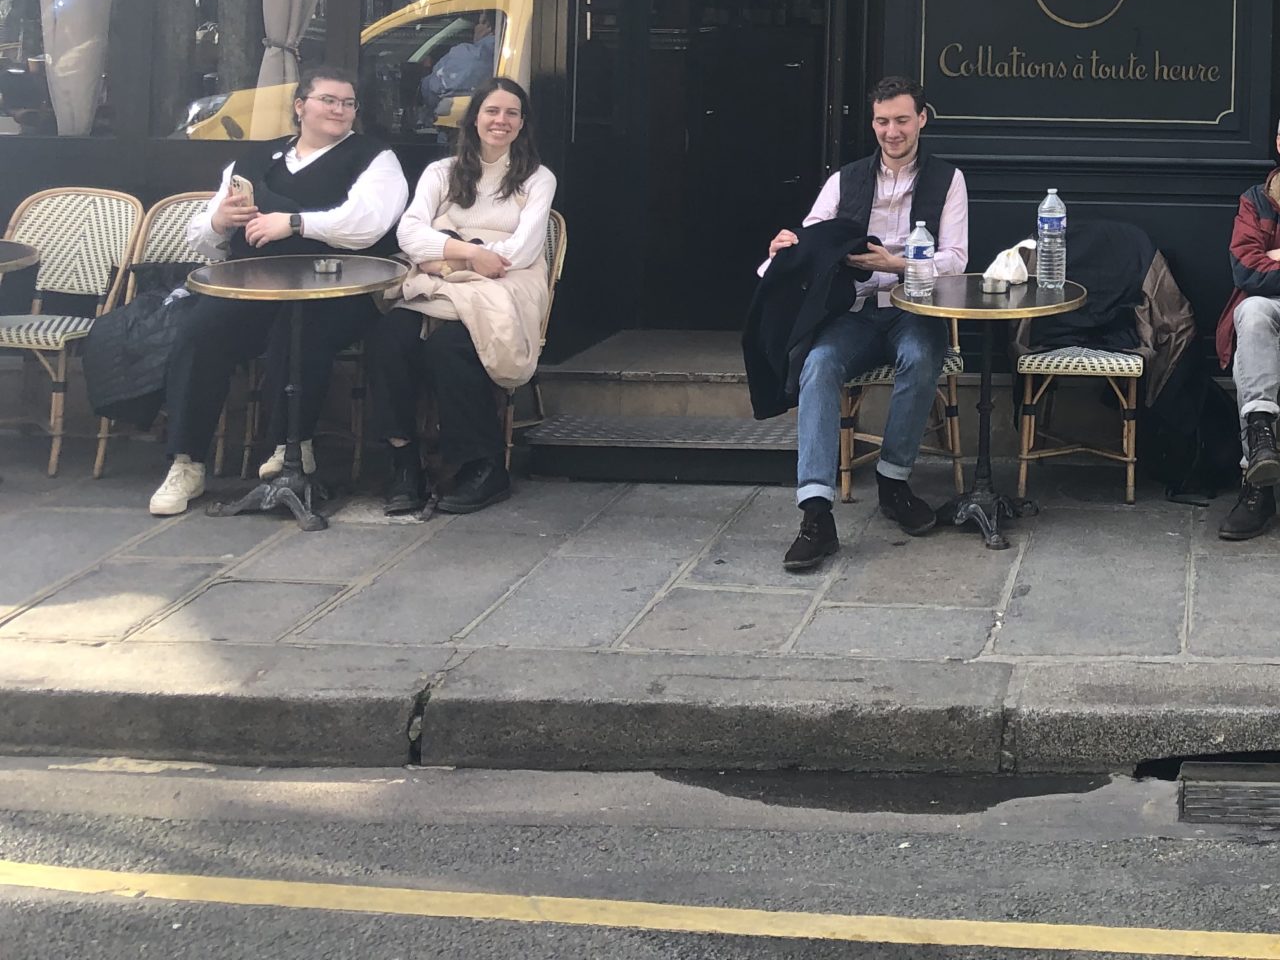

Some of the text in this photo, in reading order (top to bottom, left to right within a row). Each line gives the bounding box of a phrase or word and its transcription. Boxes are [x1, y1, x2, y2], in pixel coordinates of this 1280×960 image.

[939, 42, 1221, 82] Collations à toute heure
